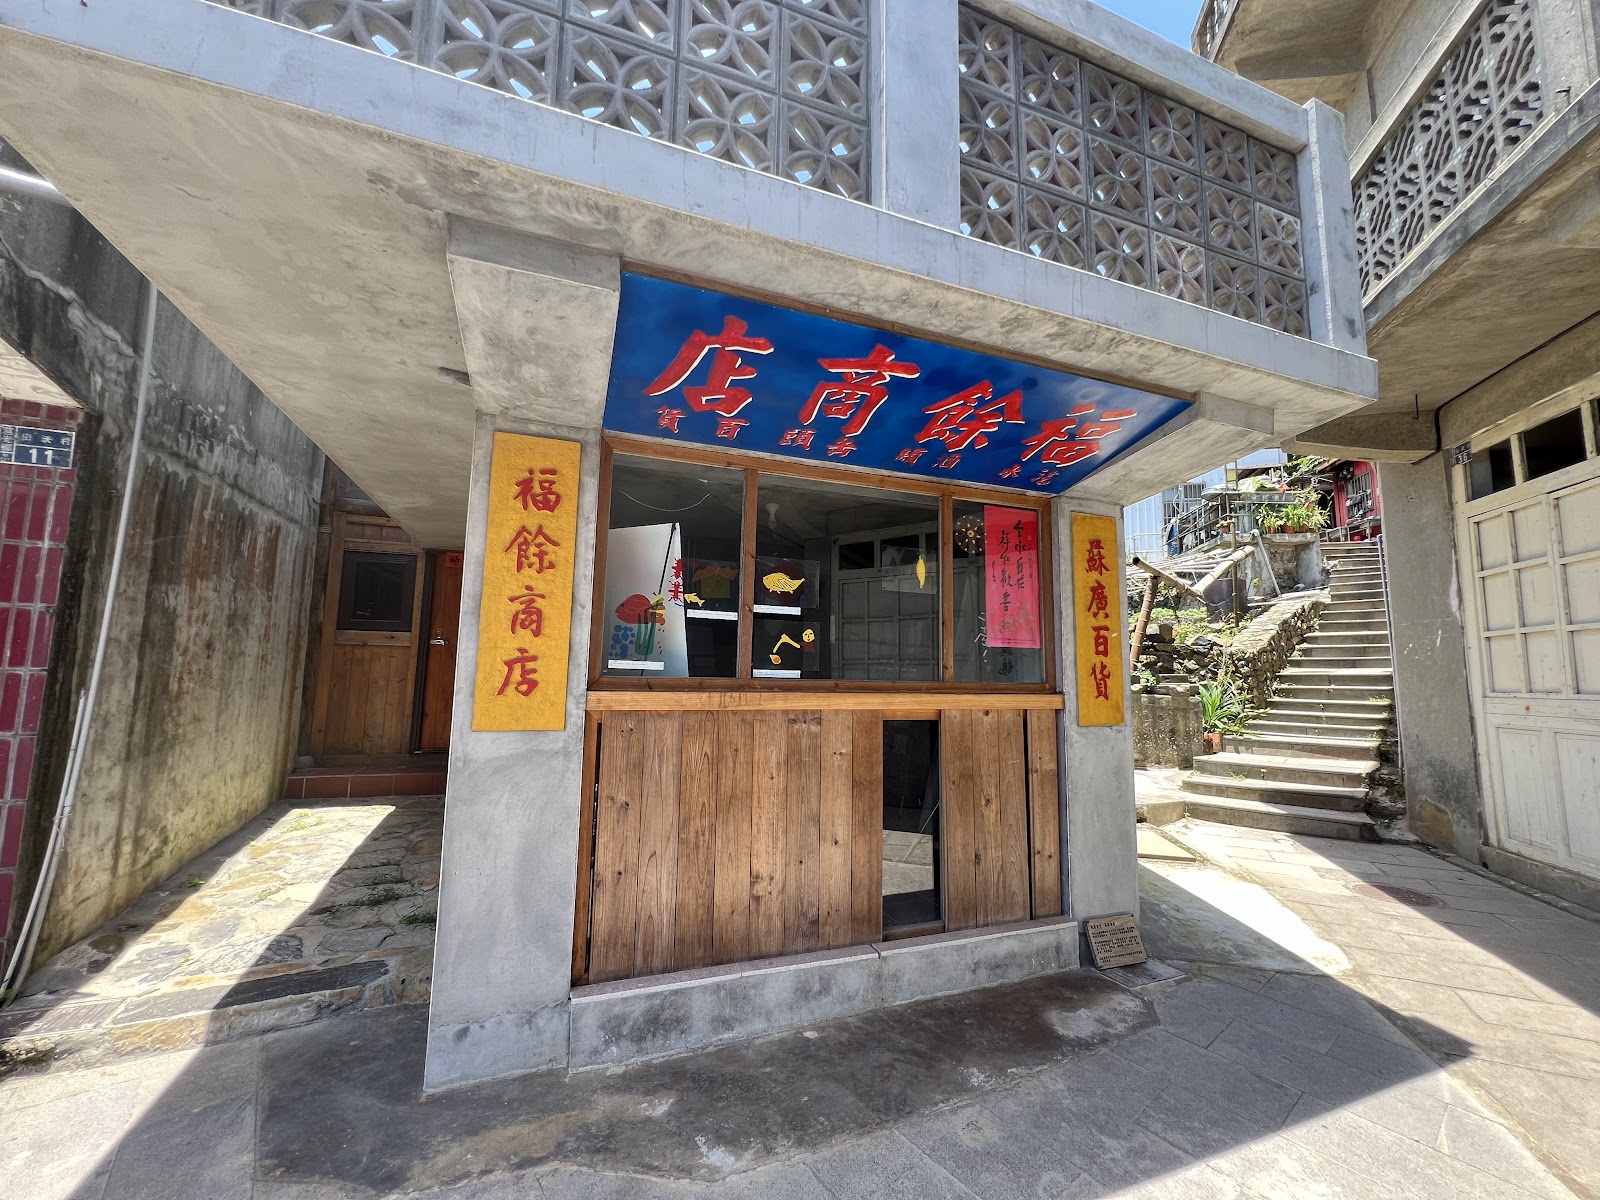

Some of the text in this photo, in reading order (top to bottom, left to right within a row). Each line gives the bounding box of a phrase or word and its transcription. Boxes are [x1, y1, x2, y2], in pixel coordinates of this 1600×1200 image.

[29, 448, 53, 465] 11
[642, 315, 1138, 468] 福餘商店
[496, 468, 562, 698] 福餘商店
[1085, 538, 1111, 701] 蘇廣百貨
